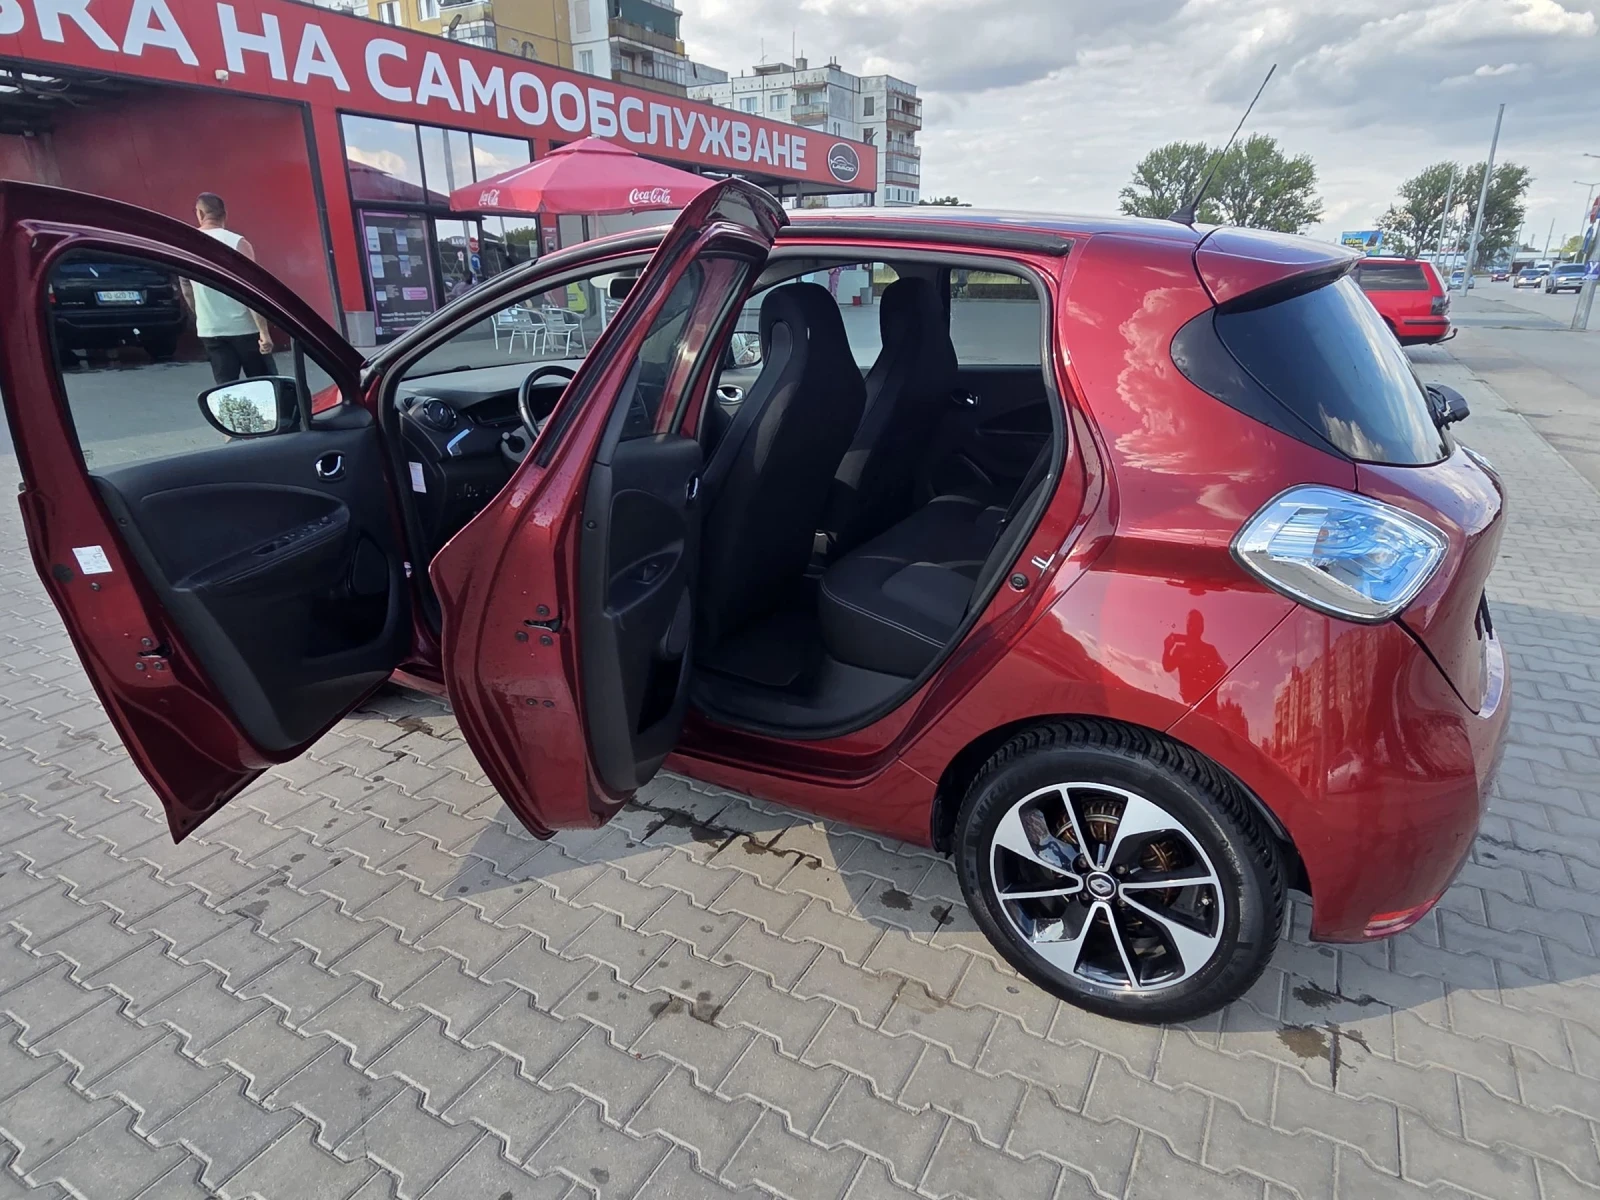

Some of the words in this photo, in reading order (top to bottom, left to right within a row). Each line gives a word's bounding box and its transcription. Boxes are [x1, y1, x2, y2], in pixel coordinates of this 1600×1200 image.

[217, 3, 351, 92] НА
[365, 38, 807, 171] САМООБСЛУЖВАНЕ
[629, 187, 671, 205] Coca-Cola
